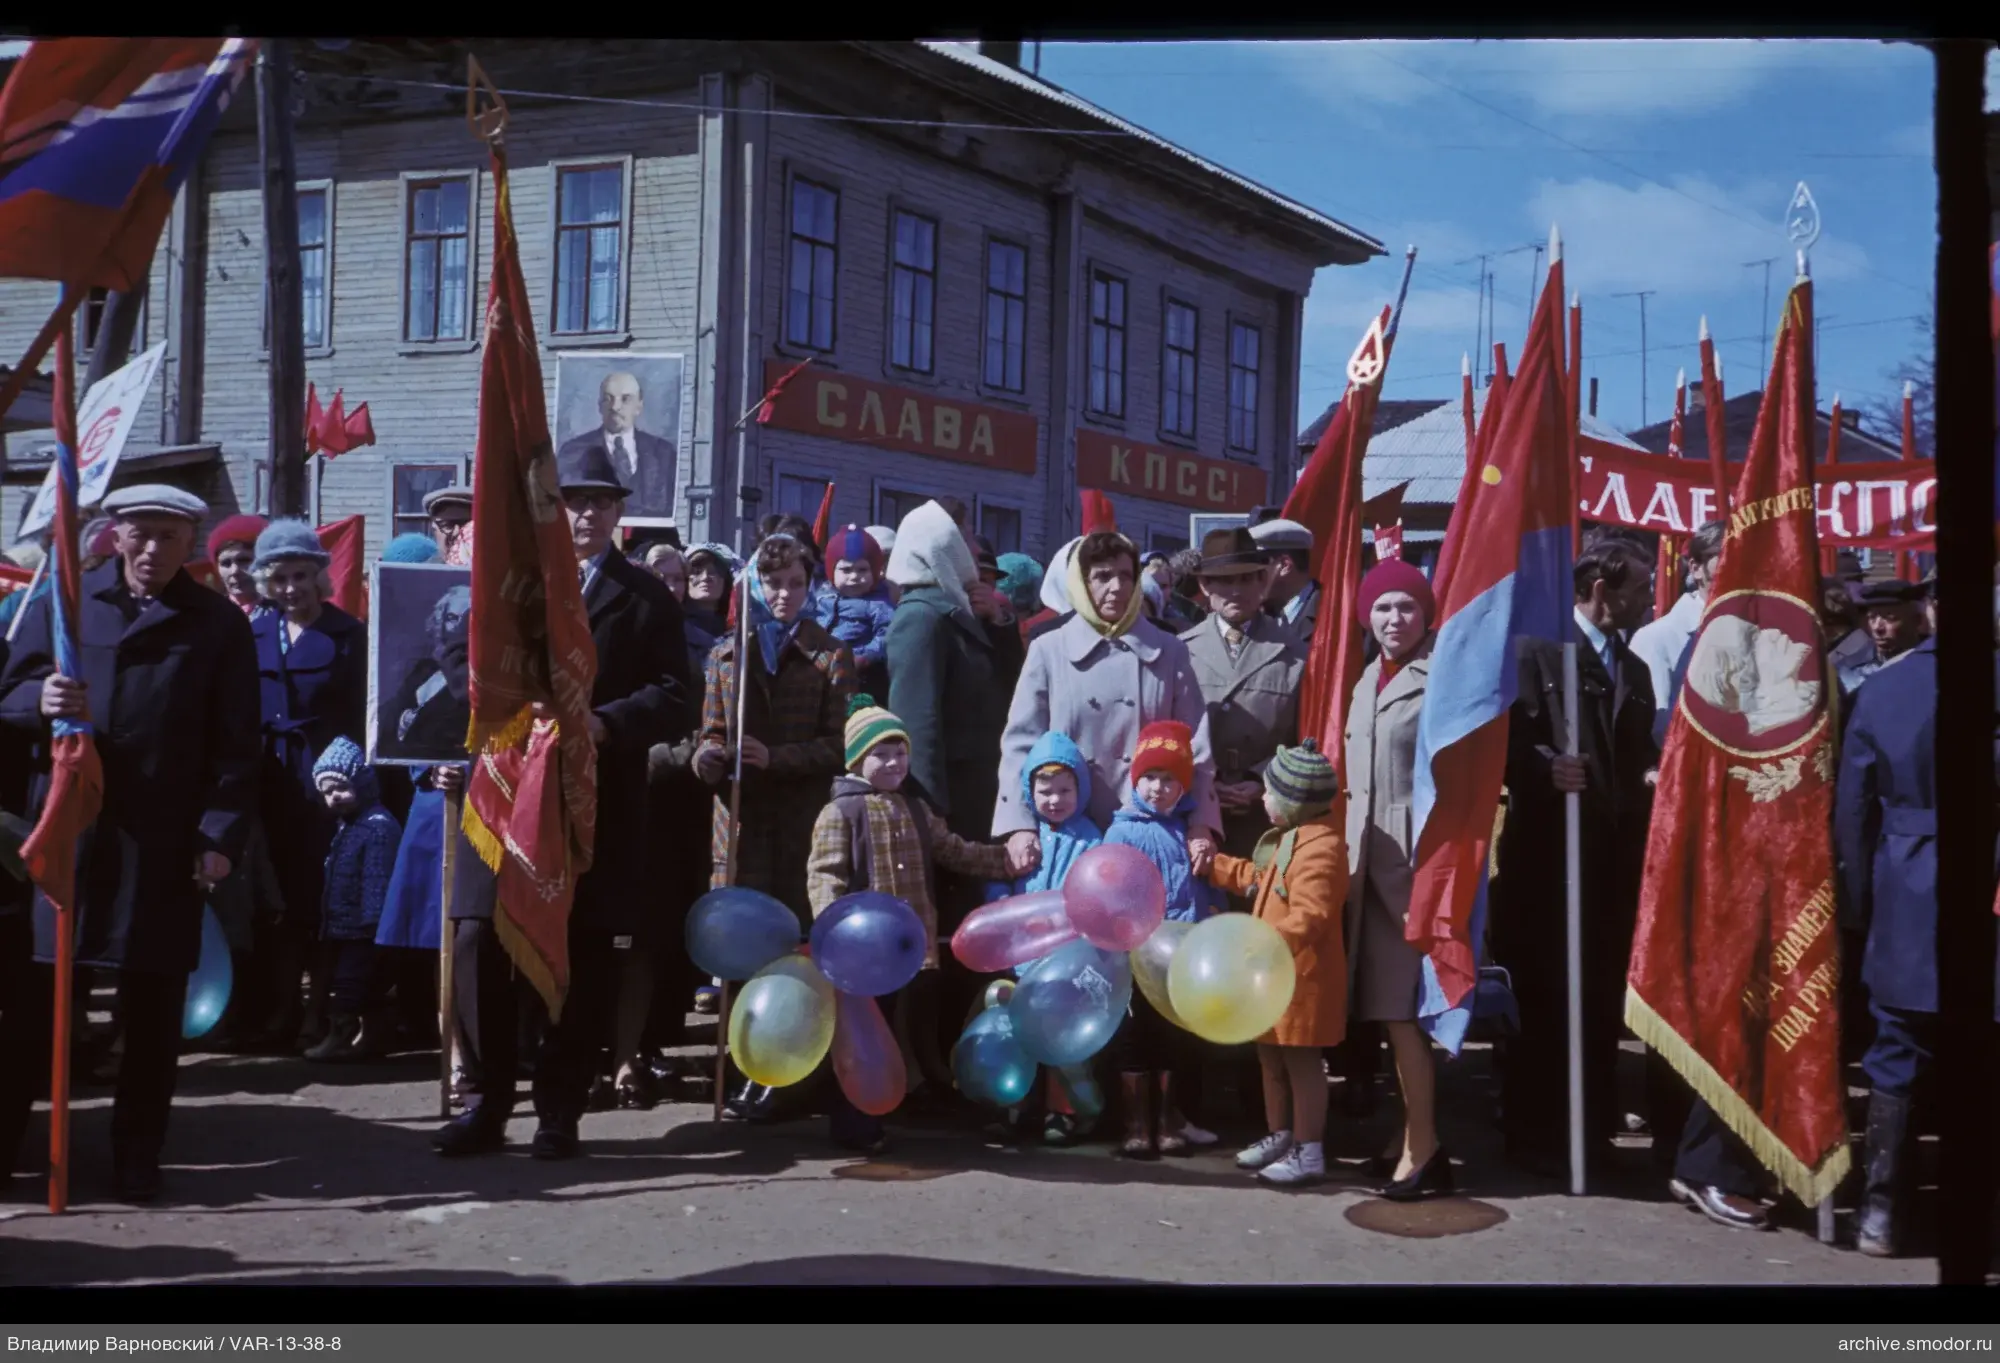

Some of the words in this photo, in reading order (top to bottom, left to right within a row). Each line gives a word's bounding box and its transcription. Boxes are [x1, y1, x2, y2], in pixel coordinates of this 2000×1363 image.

[816, 380, 994, 457] СЛАВА
[1110, 444, 1239, 506] КПСС!
[695, 503, 704, 517] 8
[1769, 1004, 1817, 1053] ПОД
